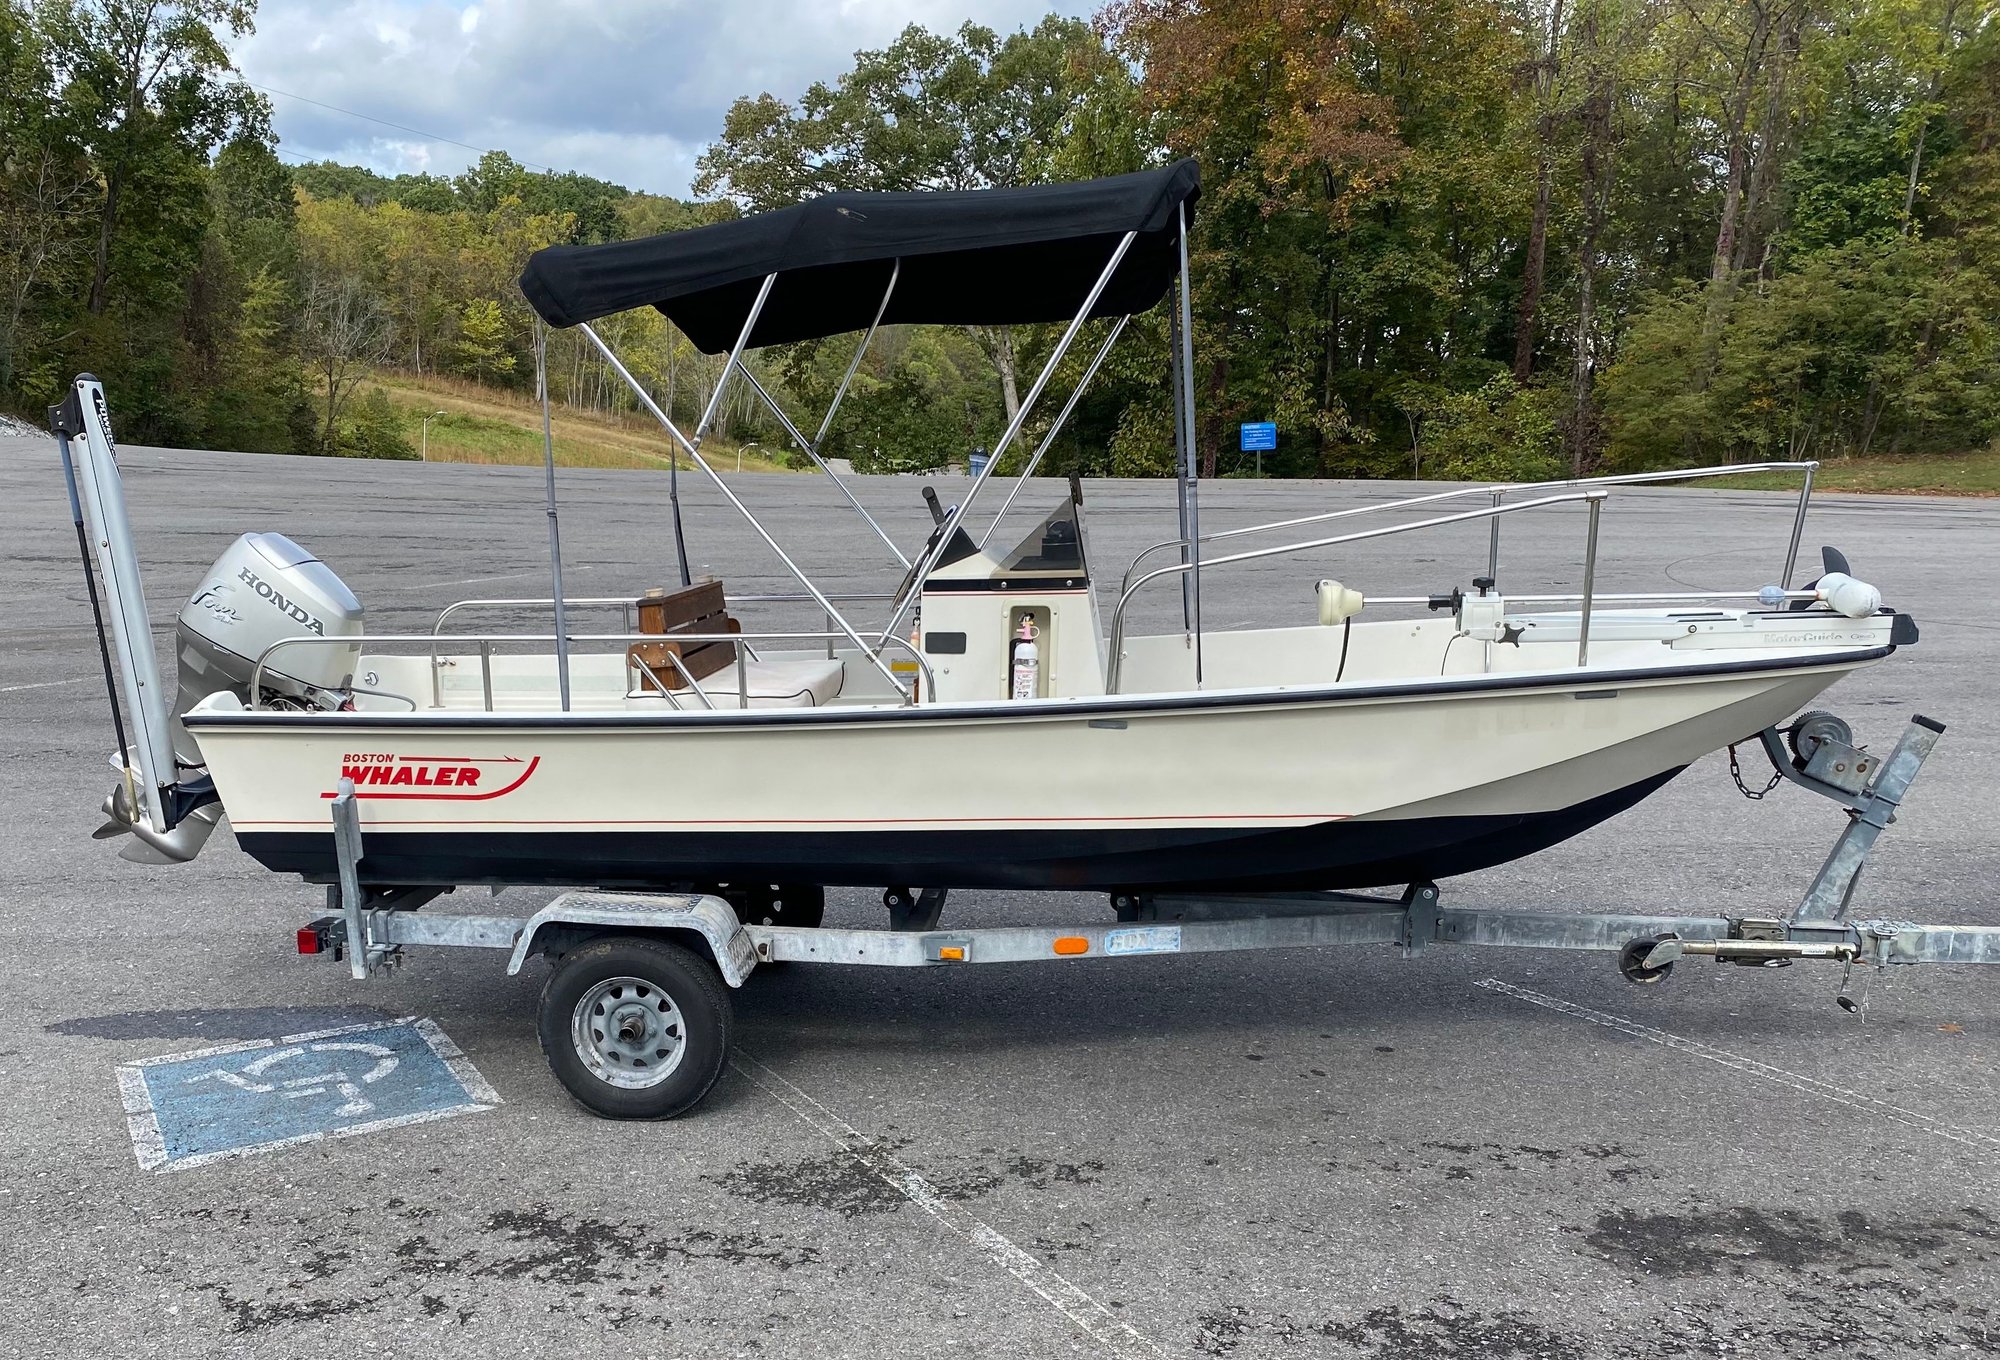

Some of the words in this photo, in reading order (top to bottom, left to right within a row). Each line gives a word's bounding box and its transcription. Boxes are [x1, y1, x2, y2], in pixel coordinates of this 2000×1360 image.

[238, 567, 325, 636] HONDA
[343, 754, 394, 763] BOSTON
[342, 766, 481, 786] WHALER
